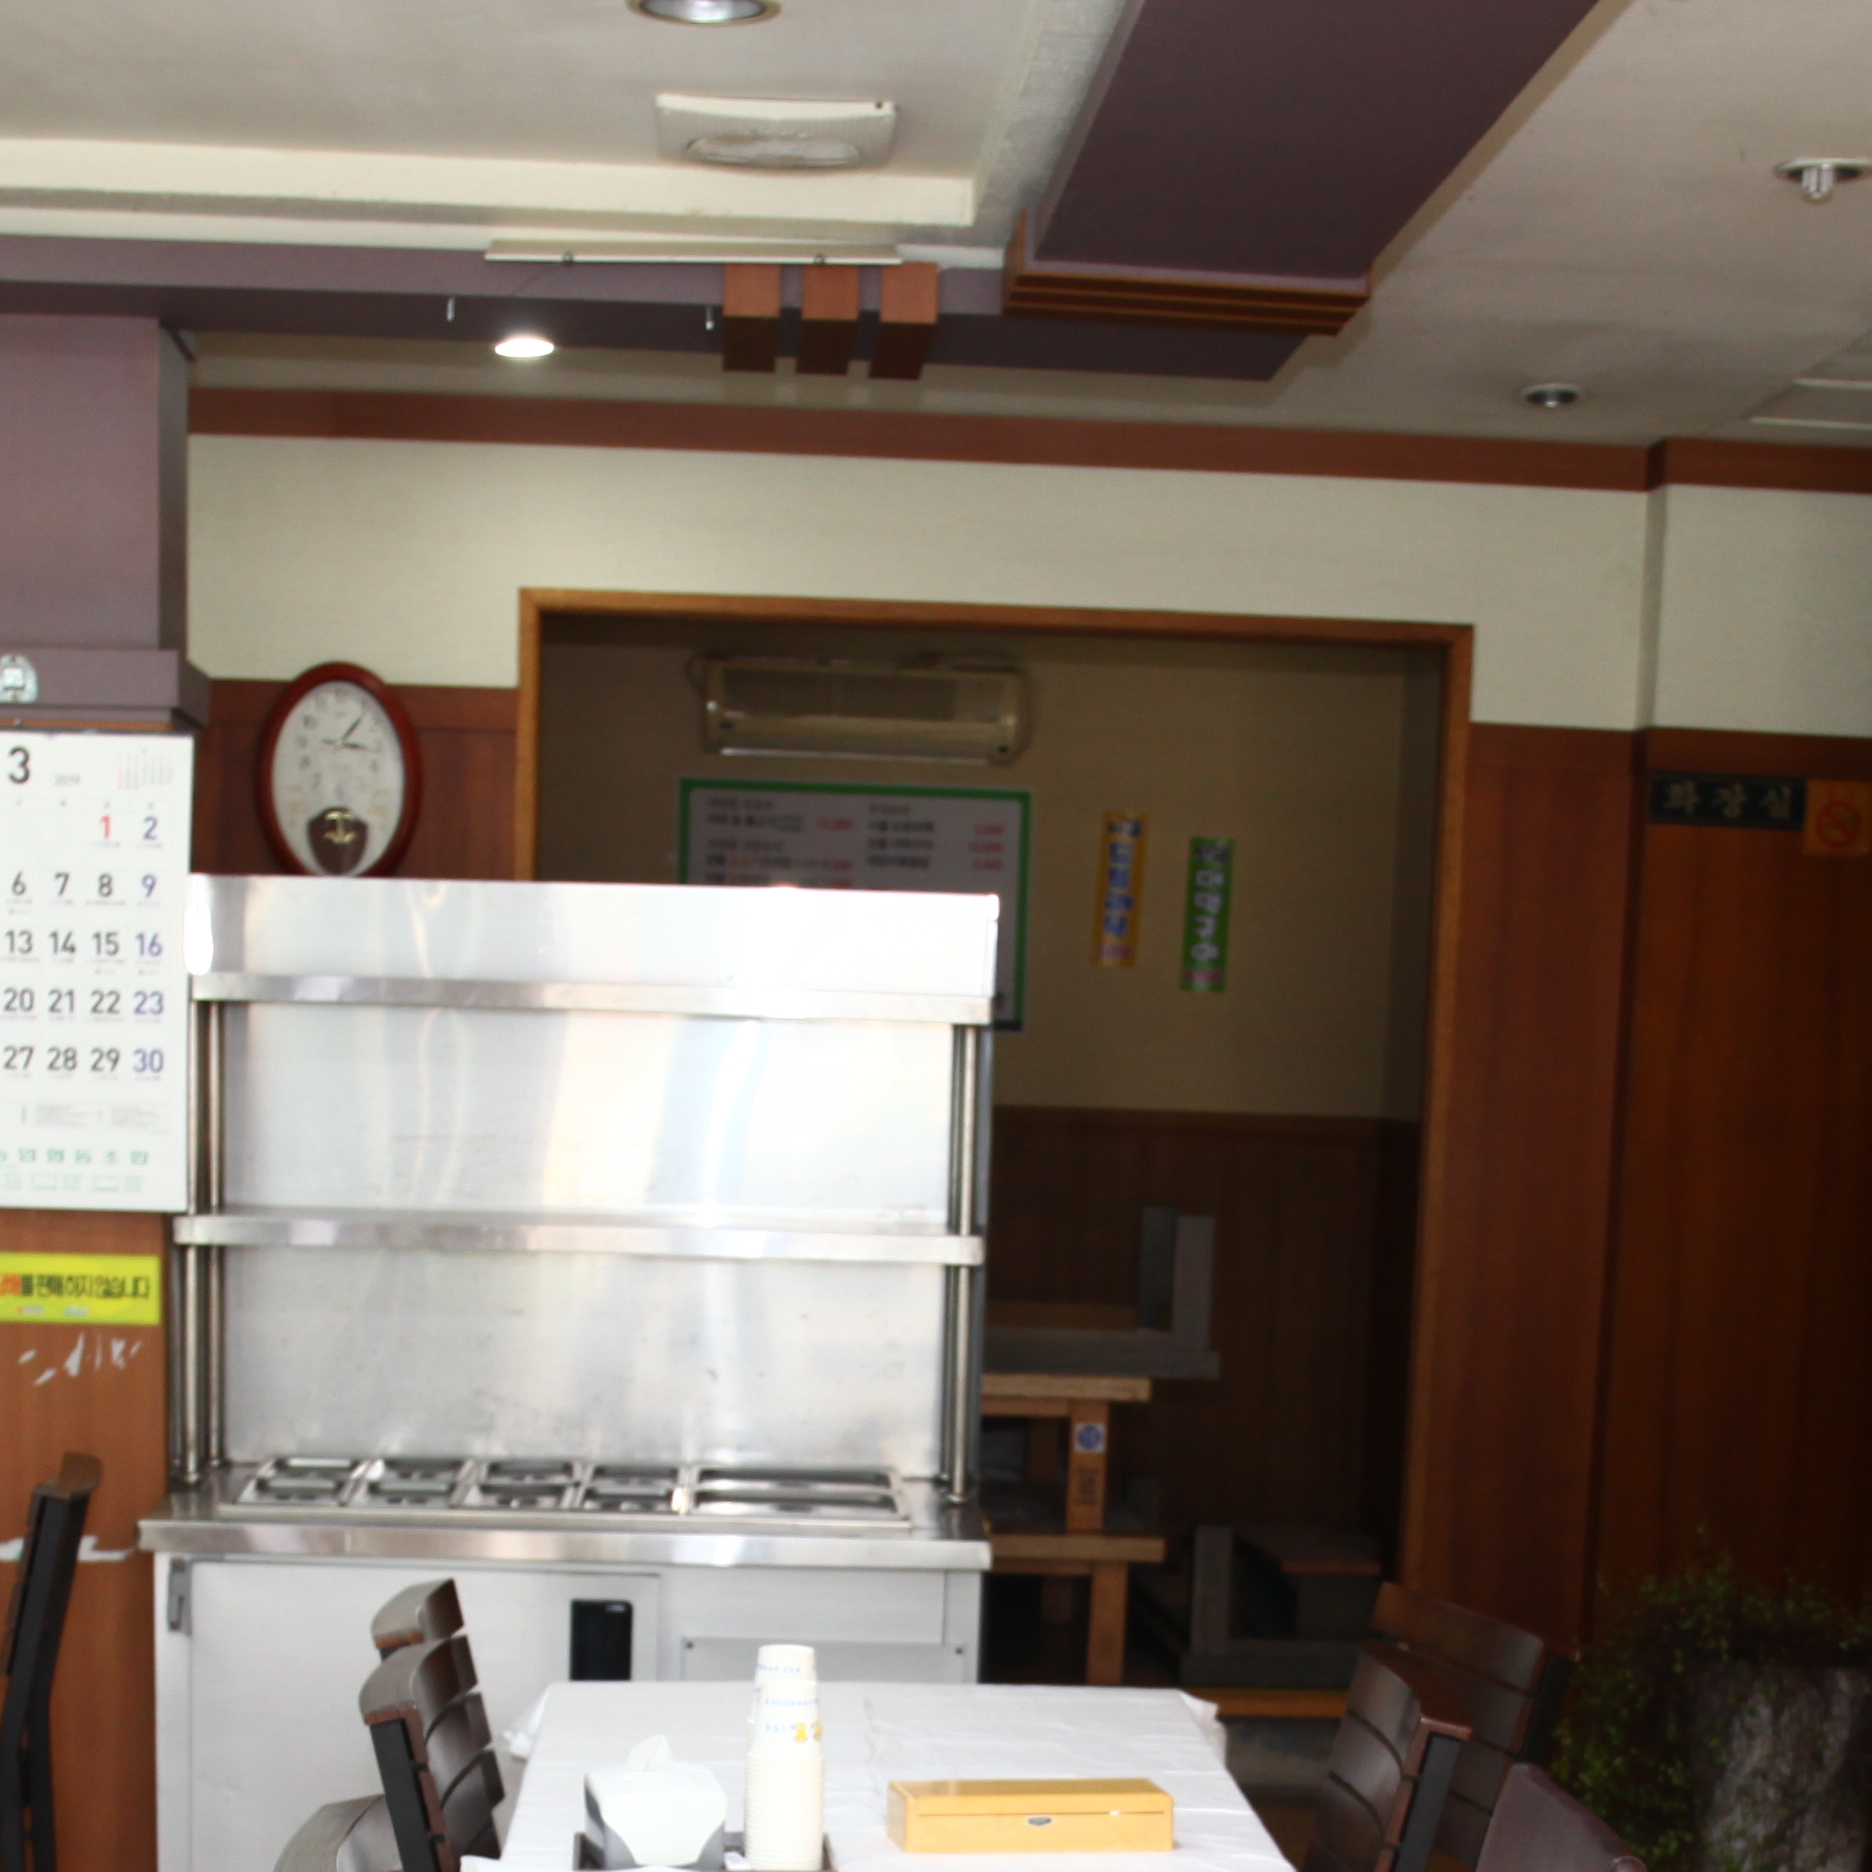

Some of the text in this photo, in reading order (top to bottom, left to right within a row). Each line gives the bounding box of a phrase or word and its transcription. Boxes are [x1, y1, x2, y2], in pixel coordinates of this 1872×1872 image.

[8, 746, 31, 785] 3
[1663, 779, 1792, 821] 화장실
[101, 816, 157, 840] 1 2
[12, 872, 26, 896] 6
[55, 872, 69, 896] 7
[98, 873, 113, 897] 8
[142, 874, 156, 897] 9
[6, 930, 32, 954] 13
[49, 931, 76, 954] 14
[93, 932, 119, 956] 15
[136, 933, 162, 956] 16
[4, 988, 34, 1012] 20
[49, 989, 74, 1013] 21
[91, 990, 120, 1014] 22
[134, 991, 163, 1015] 23
[4, 1046, 34, 1069] 27
[48, 1047, 77, 1071] 28
[91, 1048, 120, 1072] 29
[134, 1049, 163, 1073] 30
